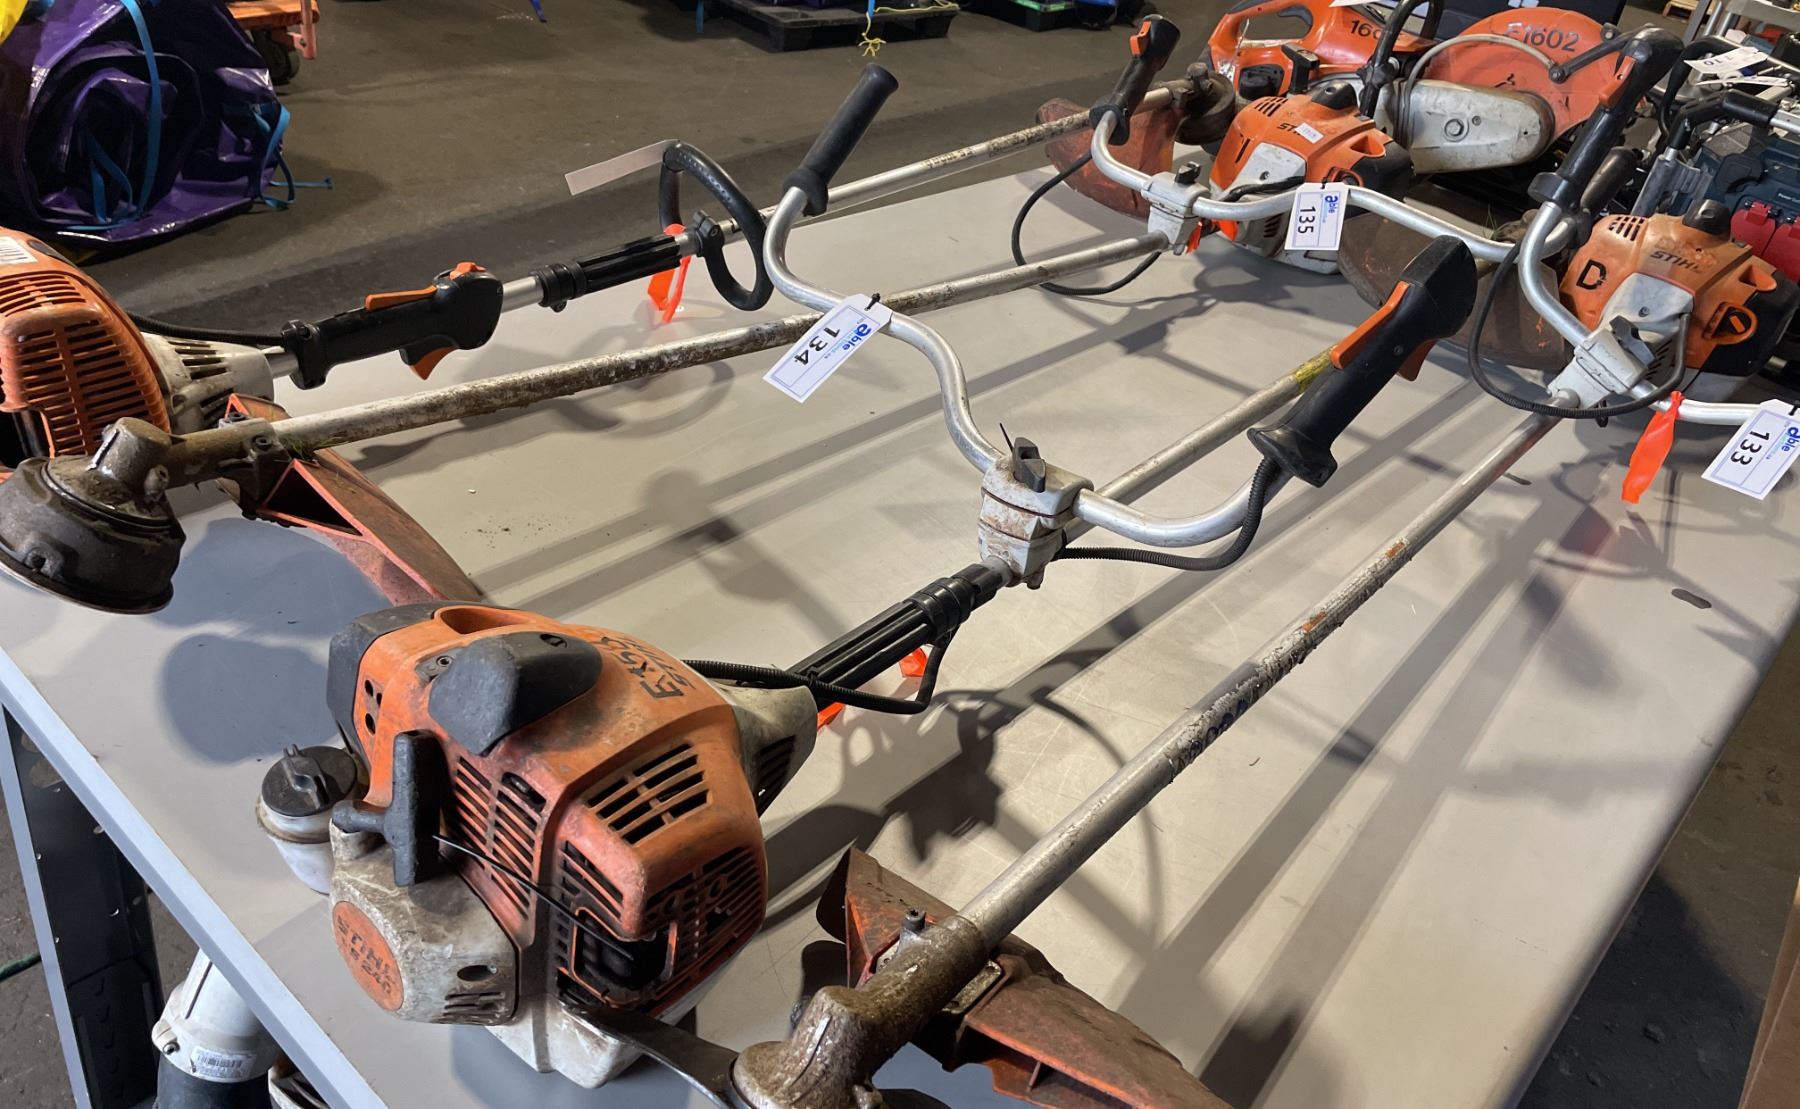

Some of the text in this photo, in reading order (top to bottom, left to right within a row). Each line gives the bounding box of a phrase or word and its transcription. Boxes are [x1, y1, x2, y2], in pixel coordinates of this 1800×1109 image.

[1297, 206, 1317, 234] 135
[1576, 258, 1607, 290] D
[1650, 250, 1703, 273] STIHL
[794, 326, 841, 366] 134
[842, 323, 872, 351] able
[1730, 430, 1770, 466] 133
